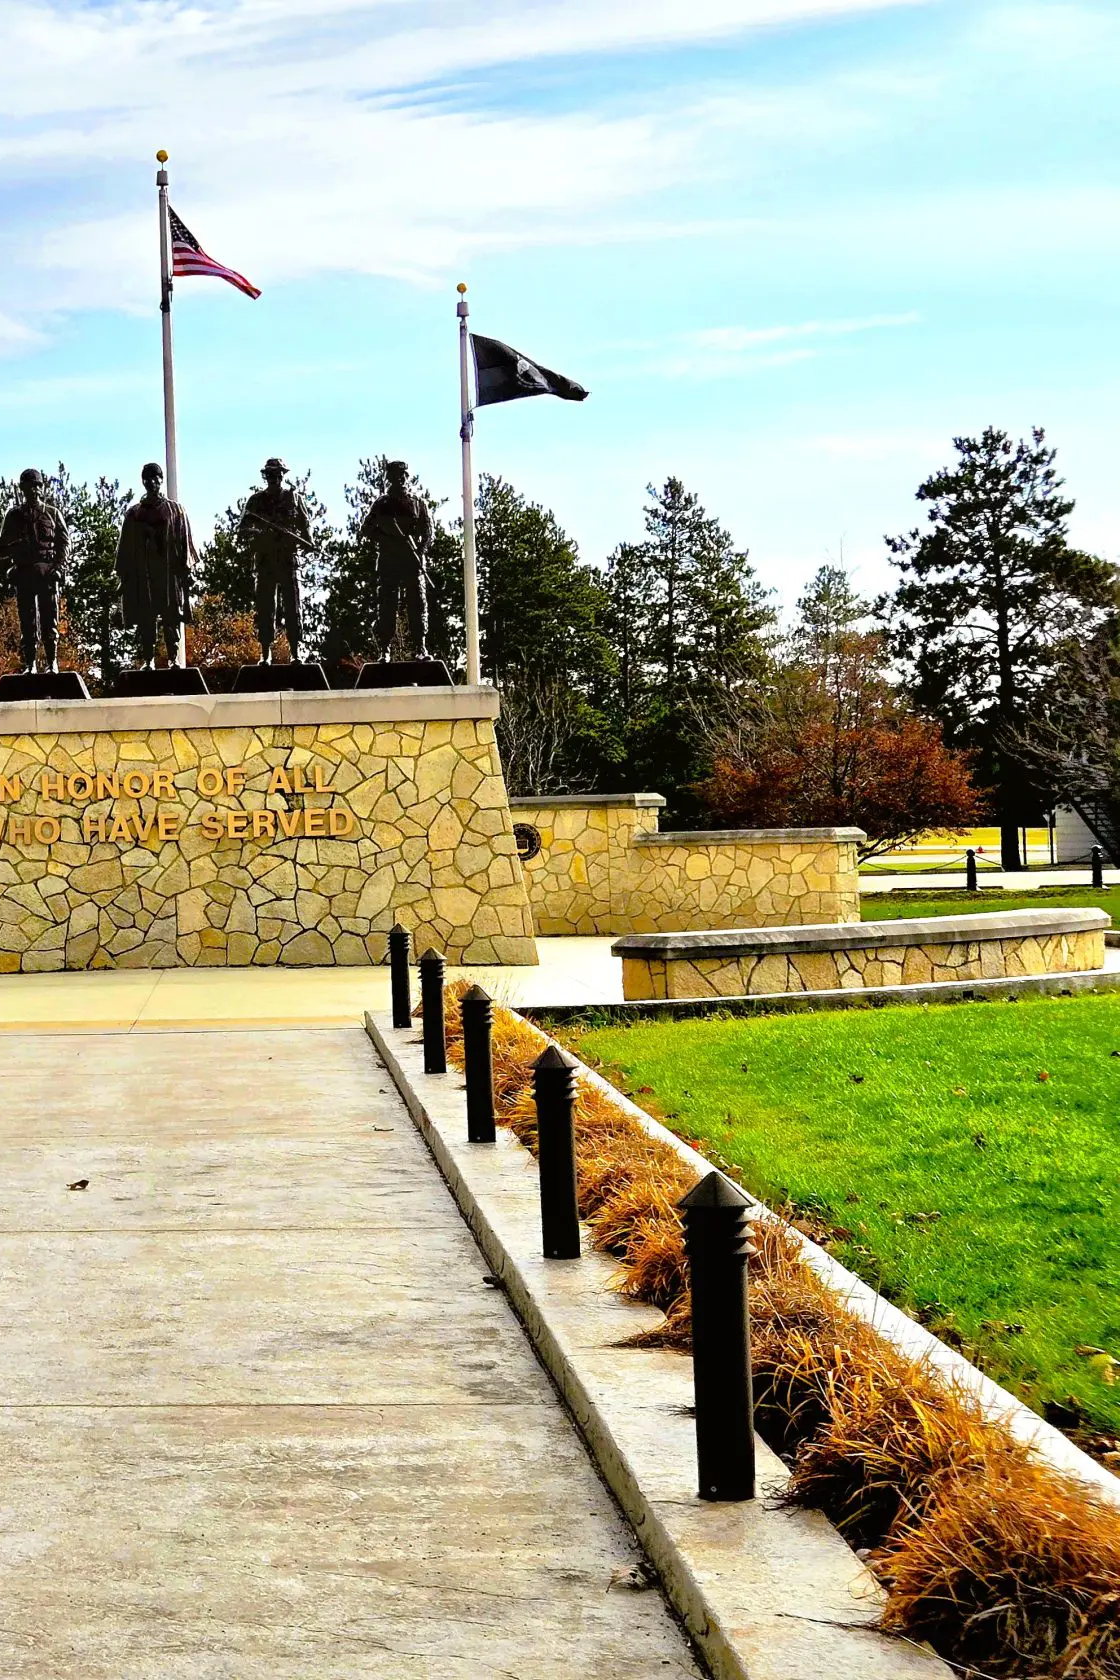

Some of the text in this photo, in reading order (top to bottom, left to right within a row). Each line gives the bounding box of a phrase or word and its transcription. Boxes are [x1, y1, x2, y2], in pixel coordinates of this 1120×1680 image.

[41, 770, 177, 800] HONOR
[197, 767, 248, 796] OF
[267, 765, 336, 794] ALL
[83, 812, 180, 843] HAVE
[201, 808, 355, 840] SERVED
